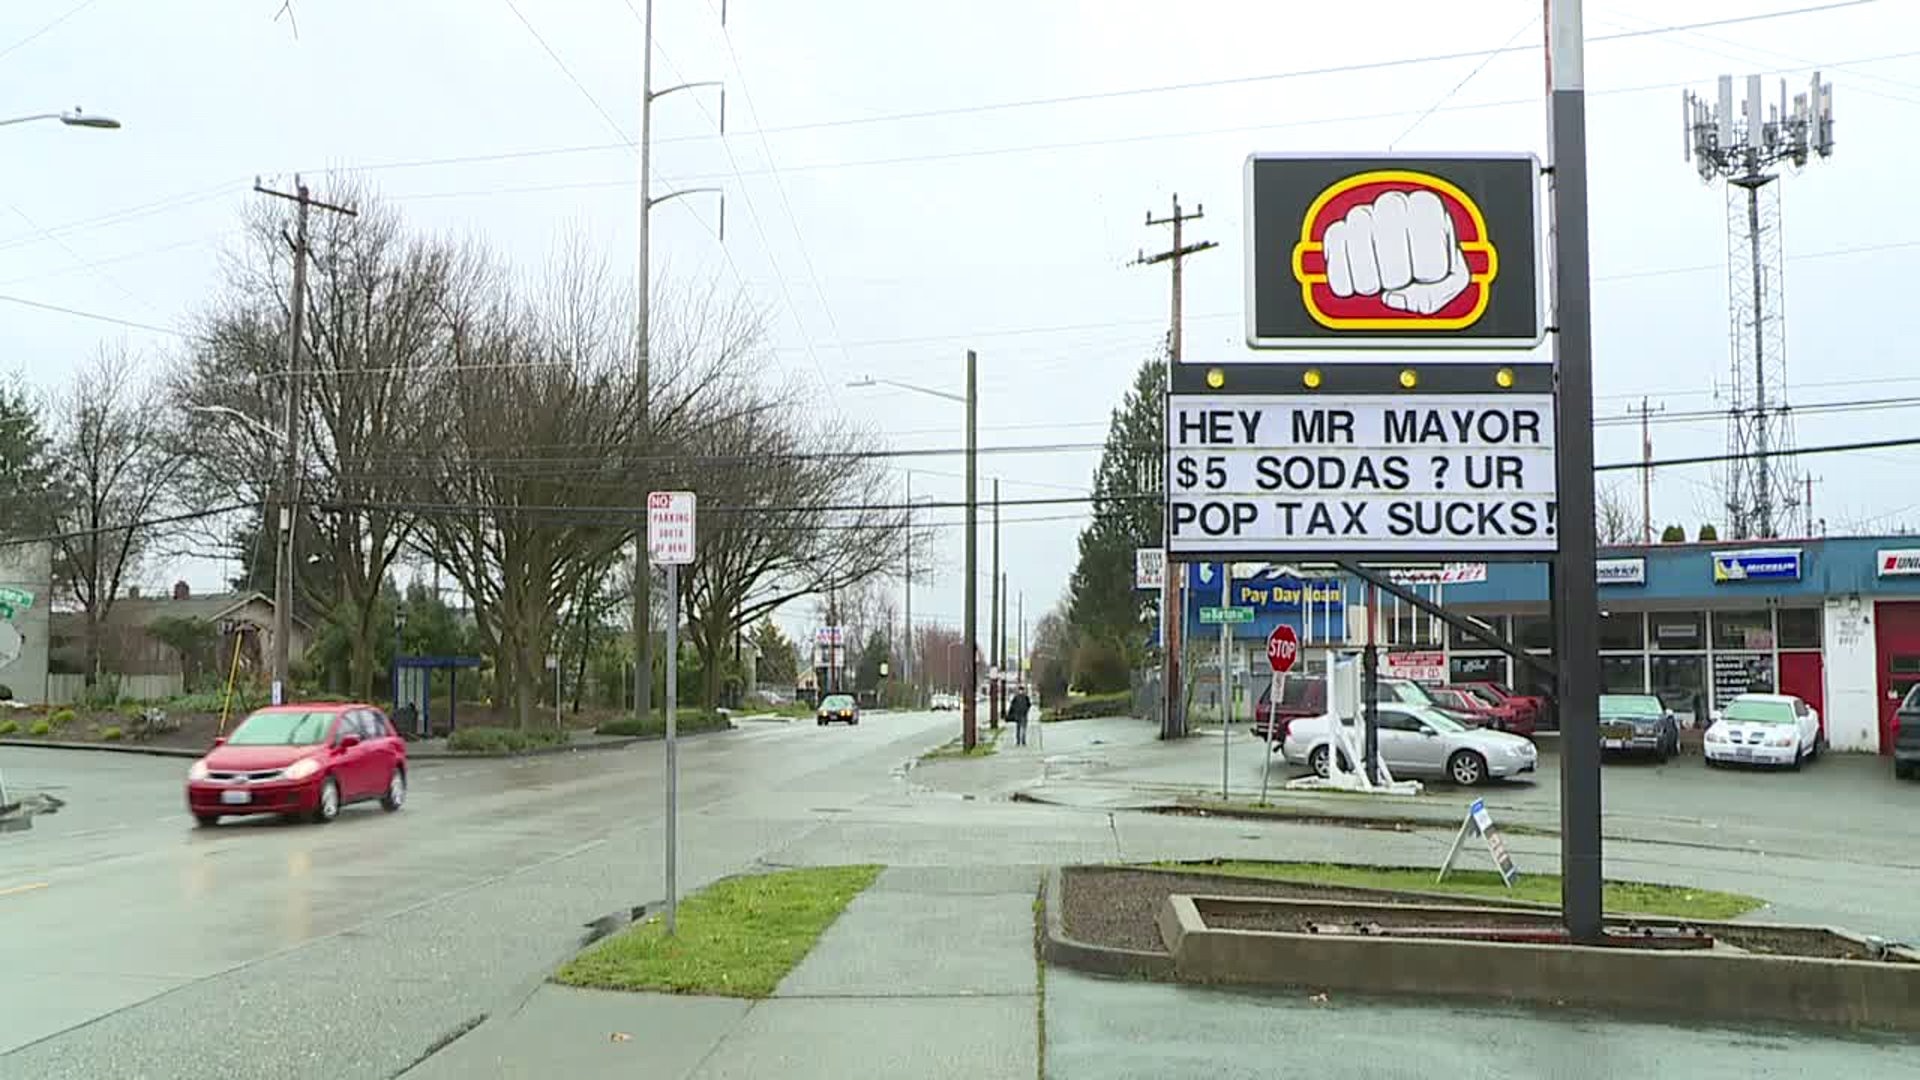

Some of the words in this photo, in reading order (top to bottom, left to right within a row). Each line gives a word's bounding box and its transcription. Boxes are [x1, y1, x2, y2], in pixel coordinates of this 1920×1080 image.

[1178, 410, 1263, 444] HEY
[1291, 410, 1355, 444] MR
[1383, 409, 1540, 443] MAYOR
[1176, 456, 1227, 489] $5
[1256, 456, 1410, 490] SODAS
[1464, 456, 1524, 489] UR
[651, 495, 670, 508] NO
[653, 513, 689, 523] PARKING
[1172, 502, 1258, 536] POP
[1276, 502, 1368, 535] TAX
[1387, 502, 1558, 536] SUCKS!
[1746, 562, 1795, 573] MICHELIN
[1241, 586, 1268, 605] Pay
[1273, 586, 1300, 605] Day
[1268, 638, 1295, 660] STOP
